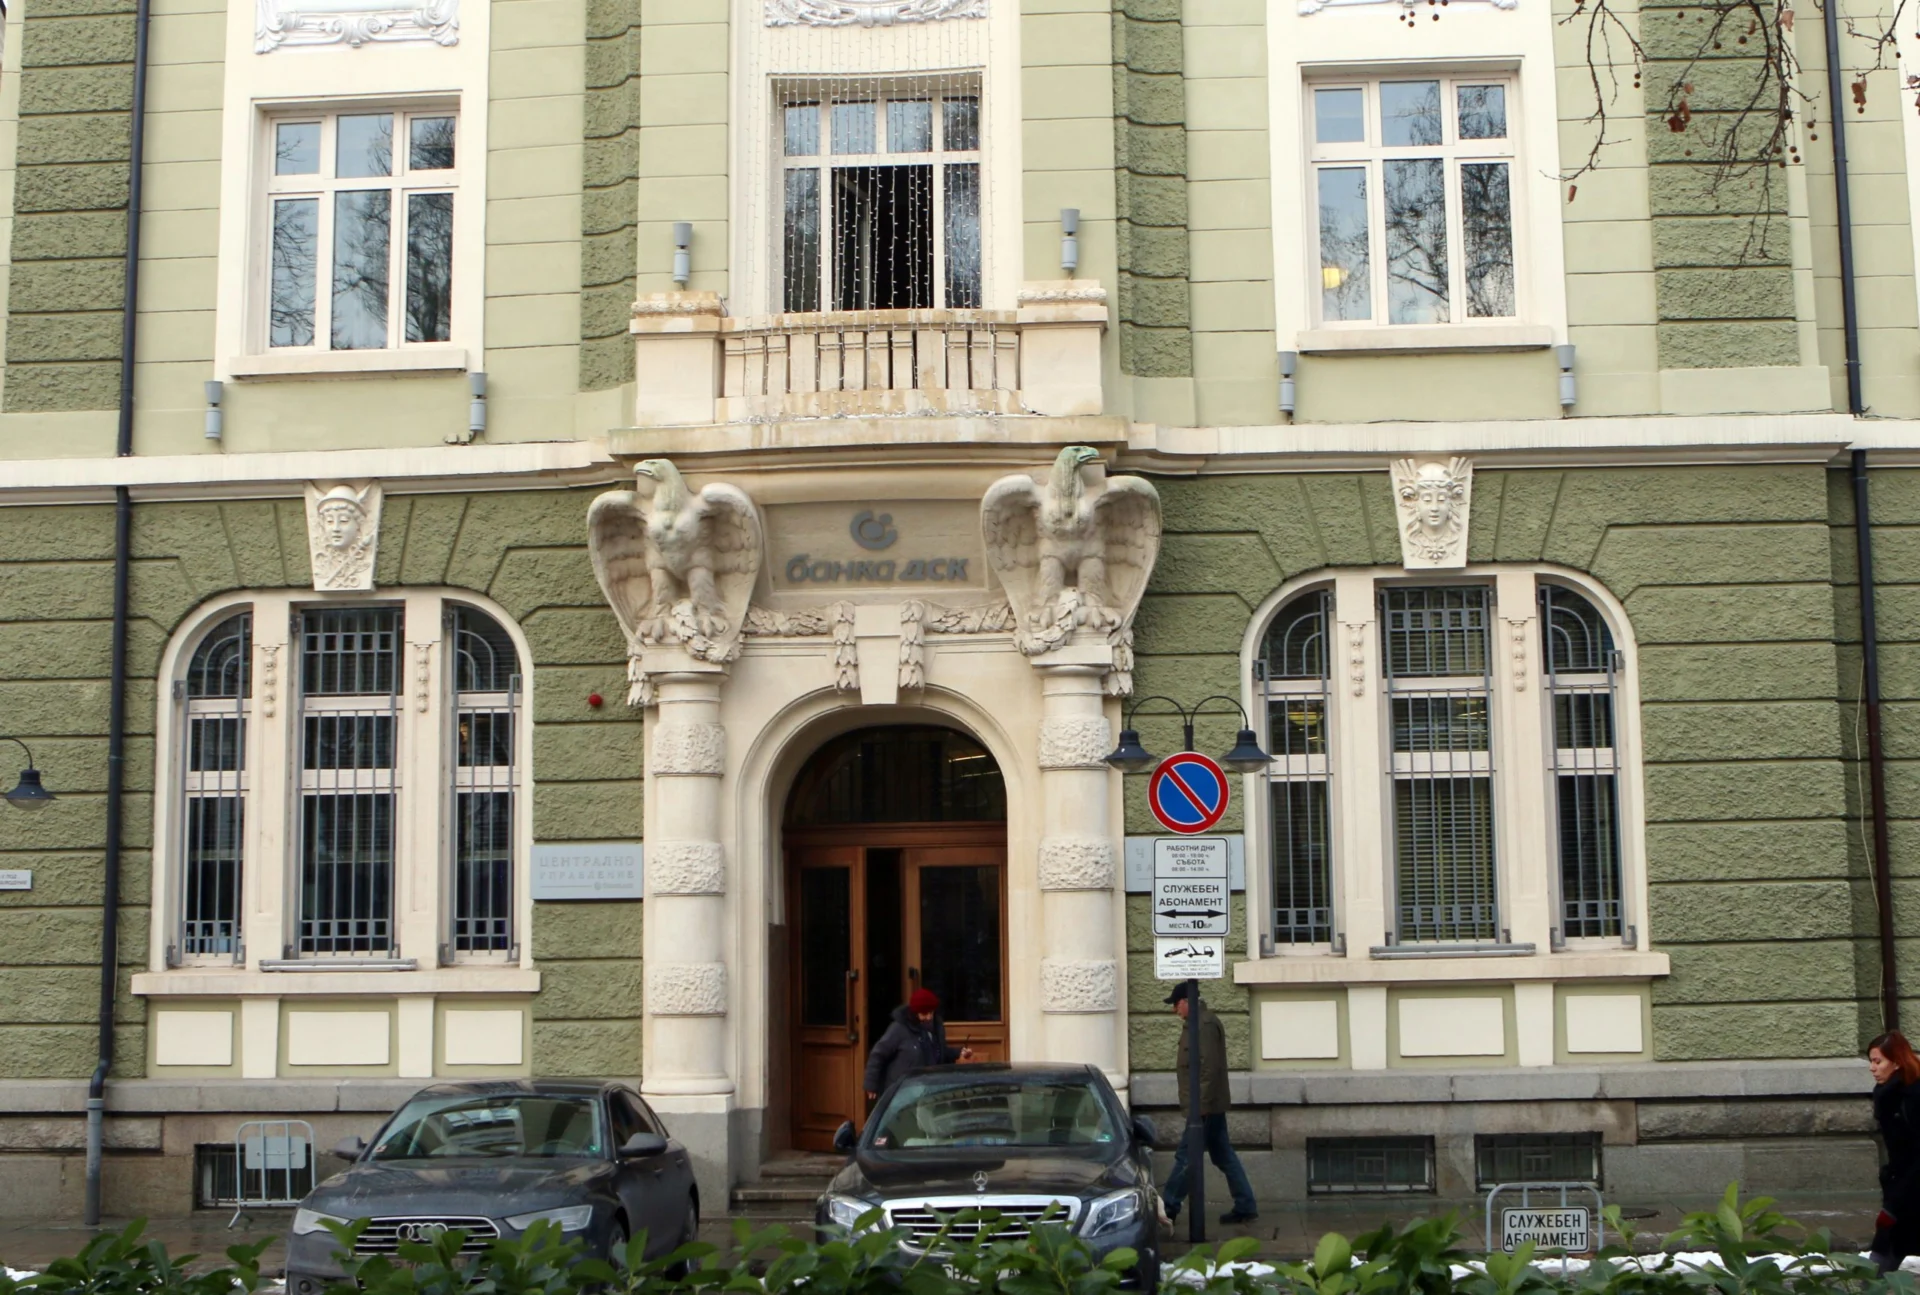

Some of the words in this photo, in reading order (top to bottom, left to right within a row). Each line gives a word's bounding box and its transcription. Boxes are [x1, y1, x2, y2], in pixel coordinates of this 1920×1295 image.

[786, 553, 896, 583] банка
[539, 855, 635, 868] ЦЕНТРАЛНО
[1163, 885, 1219, 894] СЛУЖЕБЕН
[1159, 898, 1223, 907] АБОНАМЕНТ
[1191, 920, 1204, 929] 10
[1509, 1214, 1581, 1228] СЛУЖЕБЕН
[1505, 1232, 1586, 1246] АБОНАМЕНТ
